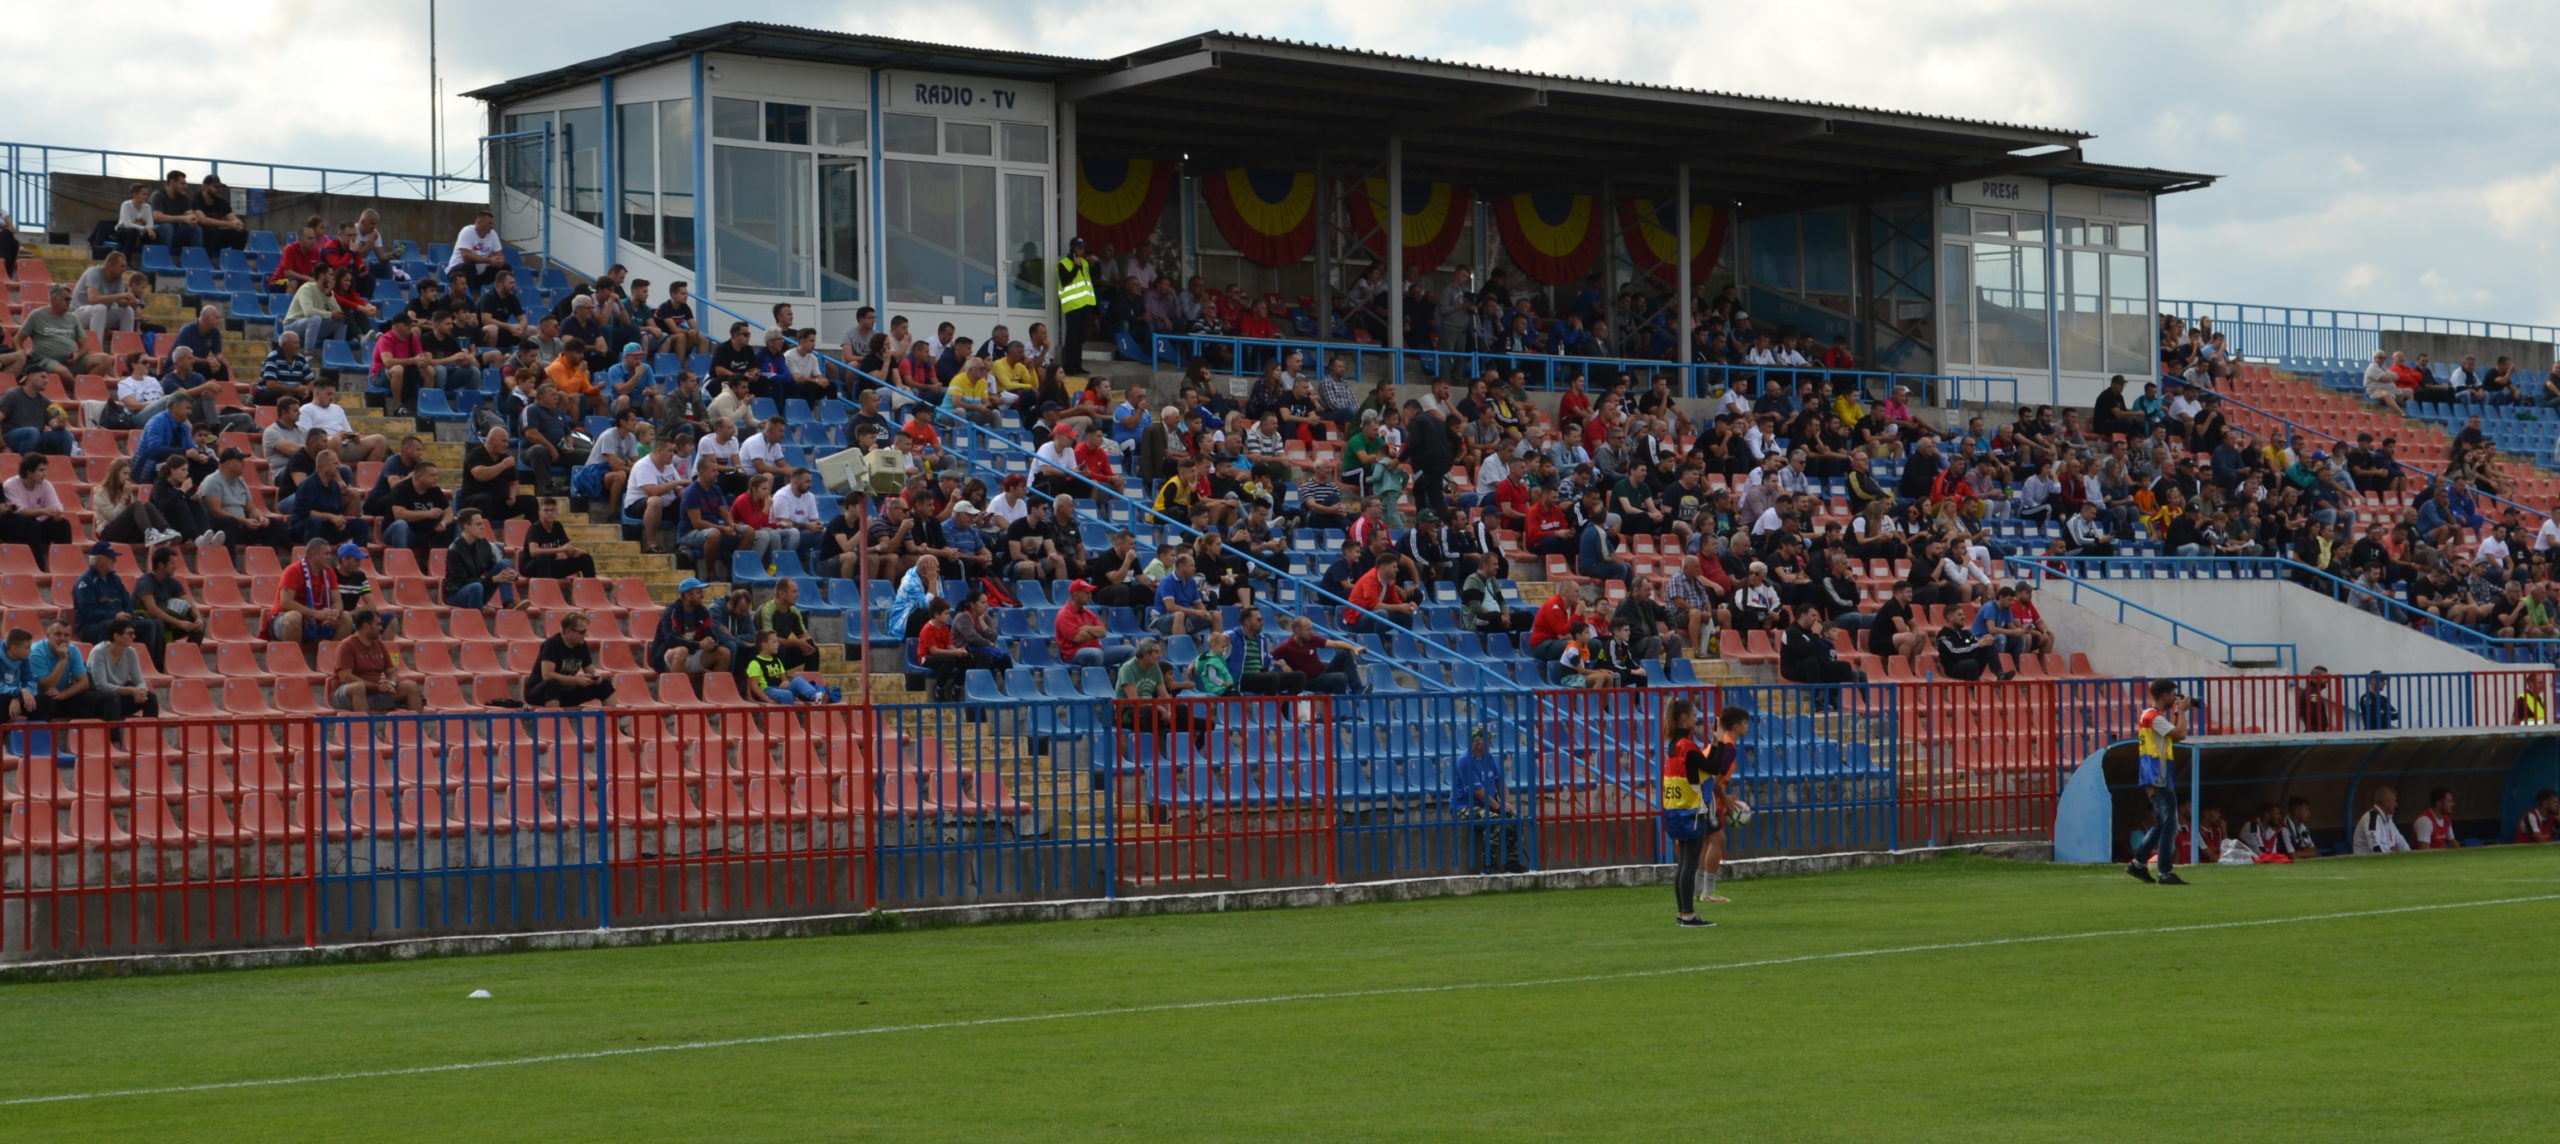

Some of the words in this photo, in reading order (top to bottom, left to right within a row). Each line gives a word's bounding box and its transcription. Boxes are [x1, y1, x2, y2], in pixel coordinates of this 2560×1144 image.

[915, 83, 973, 107] RADIO
[993, 90, 1015, 109] TV
[1982, 182, 2019, 200] PRESA
[1122, 338, 1127, 350] 1
[1158, 341, 1164, 352] 2
